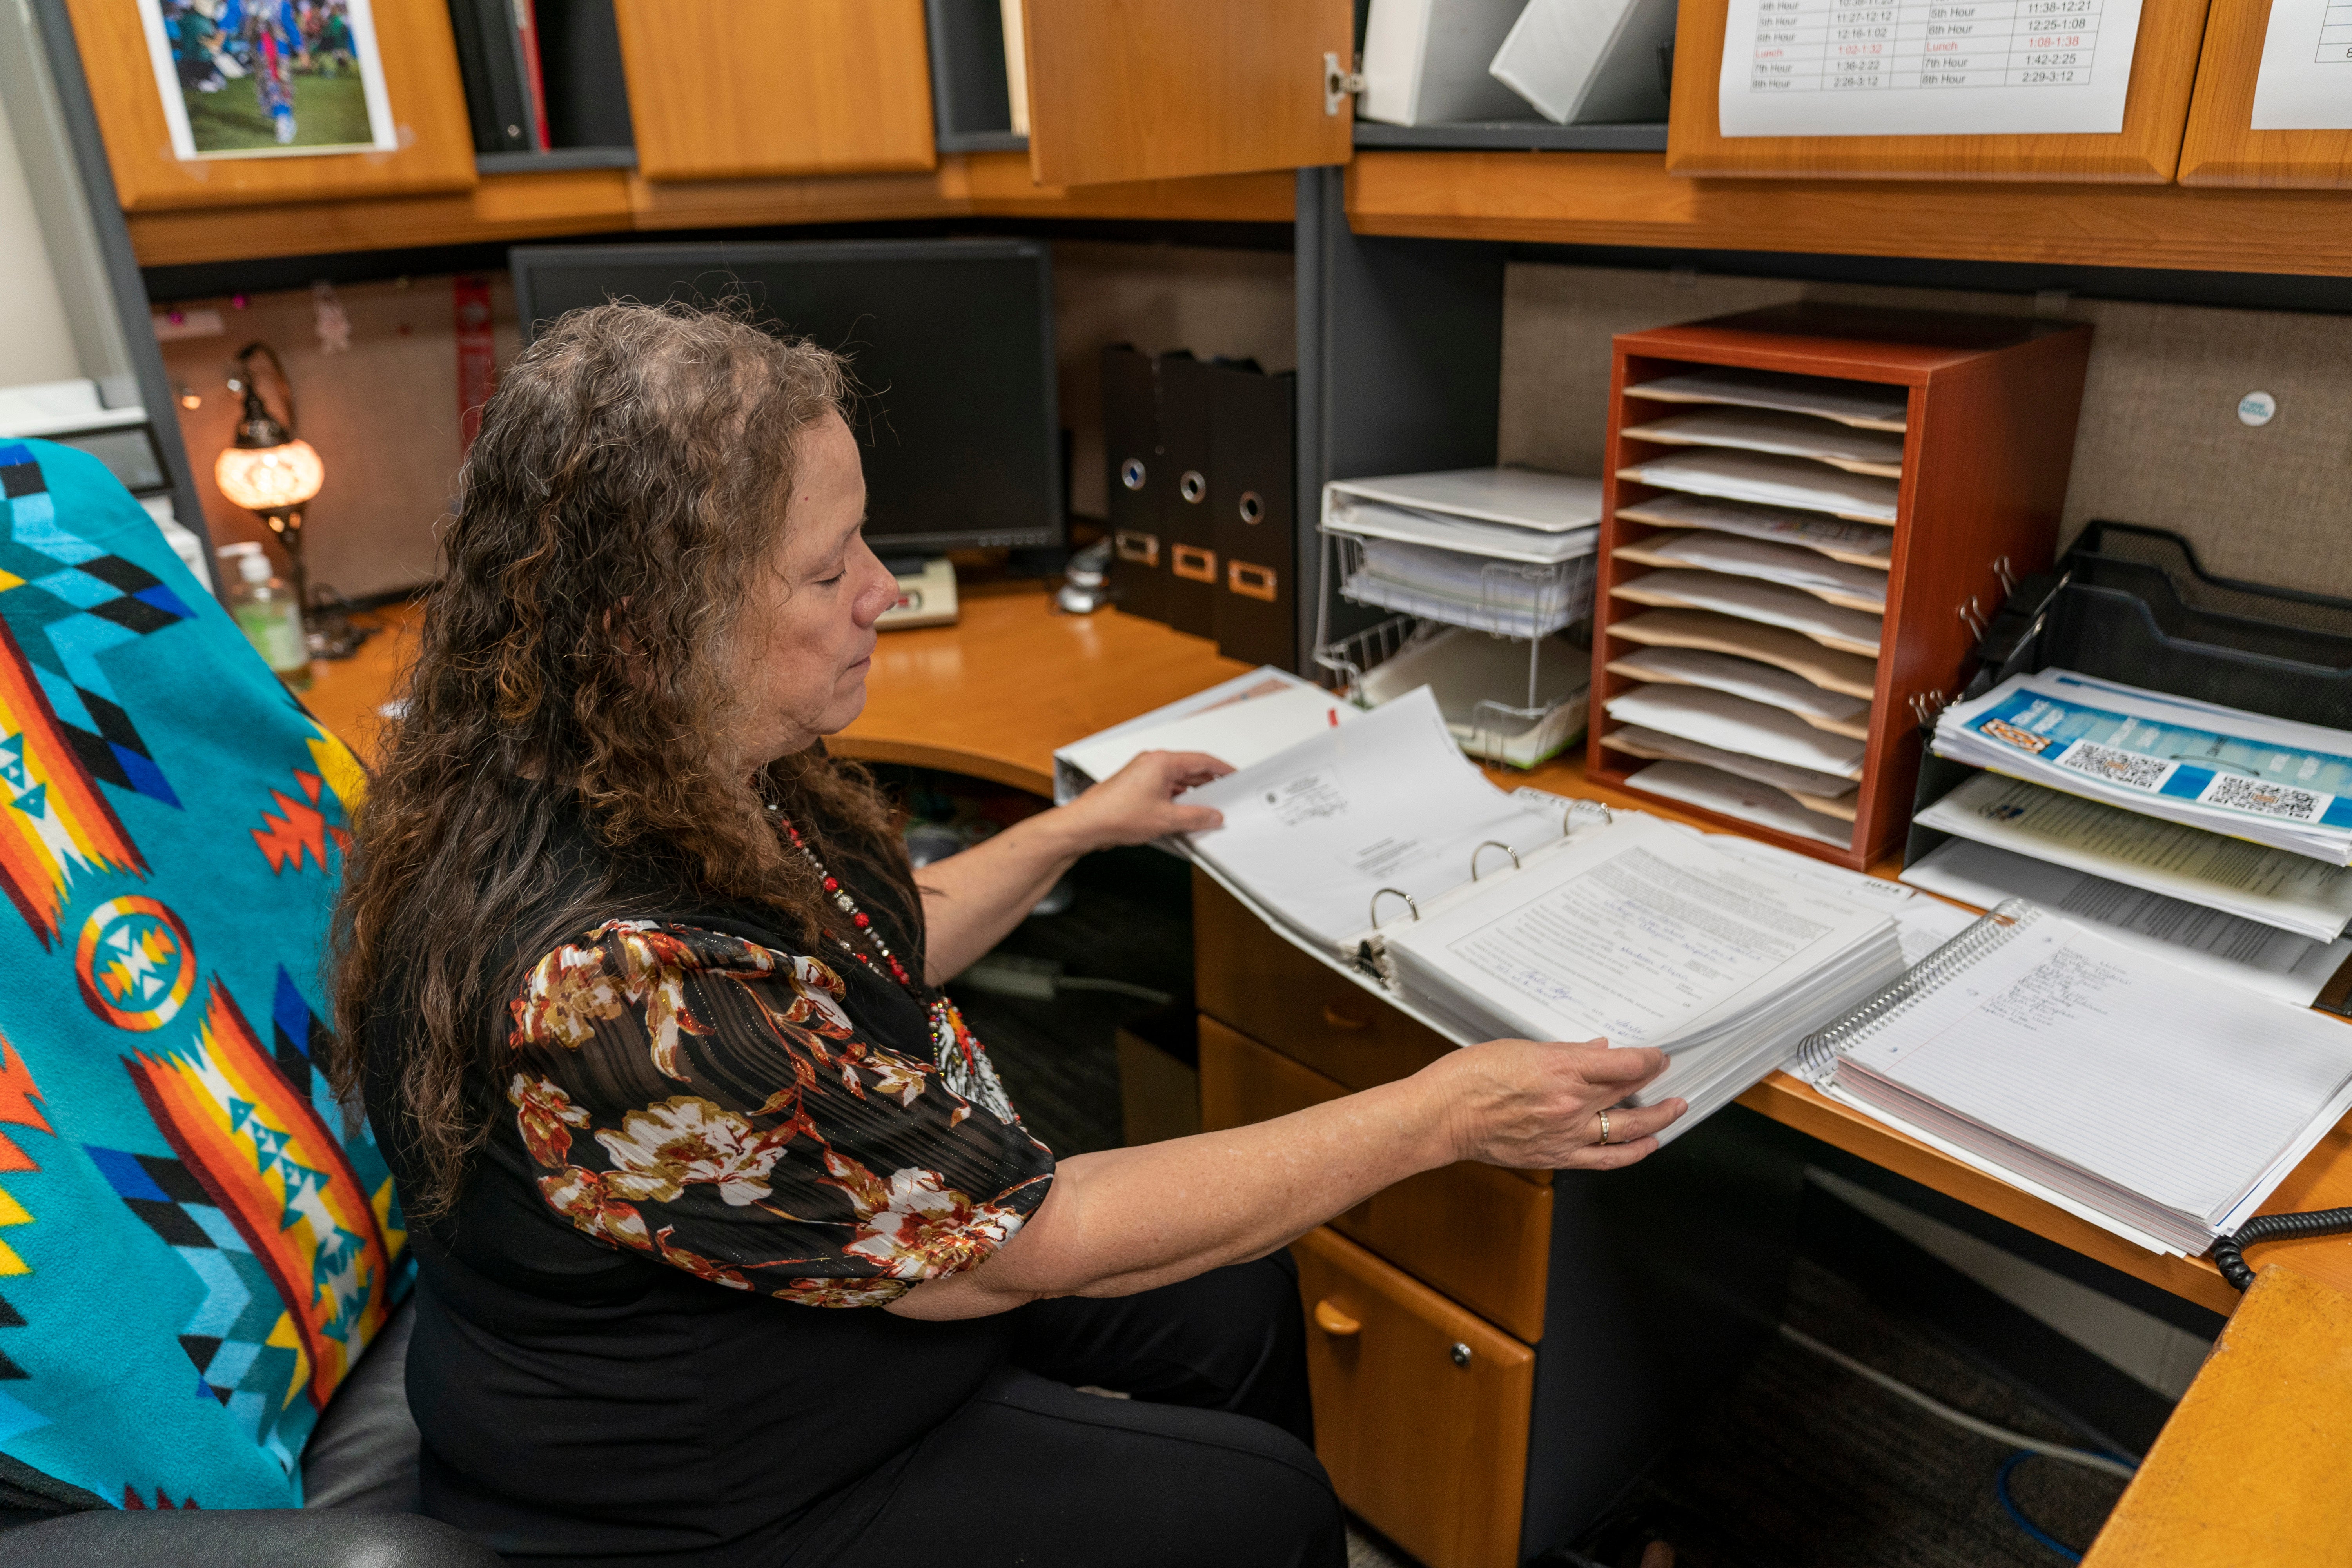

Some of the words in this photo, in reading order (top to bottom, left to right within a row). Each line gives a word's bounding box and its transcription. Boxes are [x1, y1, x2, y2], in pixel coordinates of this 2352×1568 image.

[1777, 1, 1800, 10] Hour
[2028, 0, 2091, 14] 11:38-12:21
[1837, 11, 1893, 23] 11:27-12:12
[1931, 8, 1946, 17] 5th
[1951, 7, 1976, 17] Hour
[1776, 17, 1798, 26] Hour
[2028, 18, 2086, 31] 12:25-1:08
[1838, 27, 1887, 38] 12:16-1:02
[1929, 26, 1944, 34] 6th
[1948, 24, 1973, 34] Hour
[1774, 33, 1796, 42] Hour
[2029, 36, 2080, 48] 1:08-1:38
[1838, 43, 1882, 55] 1:02-1:32
[1926, 42, 1958, 52] Lunch
[1755, 48, 1784, 58] Lunch
[1924, 59, 1940, 68] 7th
[1943, 57, 1968, 67] Hour
[2026, 53, 2076, 65] 1:42-2:25
[1754, 65, 1767, 73] 7th
[1770, 64, 1793, 73] Hour
[1922, 75, 1937, 84] 8th
[1941, 74, 1966, 84] Hour
[2022, 71, 2074, 82] 2:29-3:12
[1769, 79, 1791, 88] Hour
